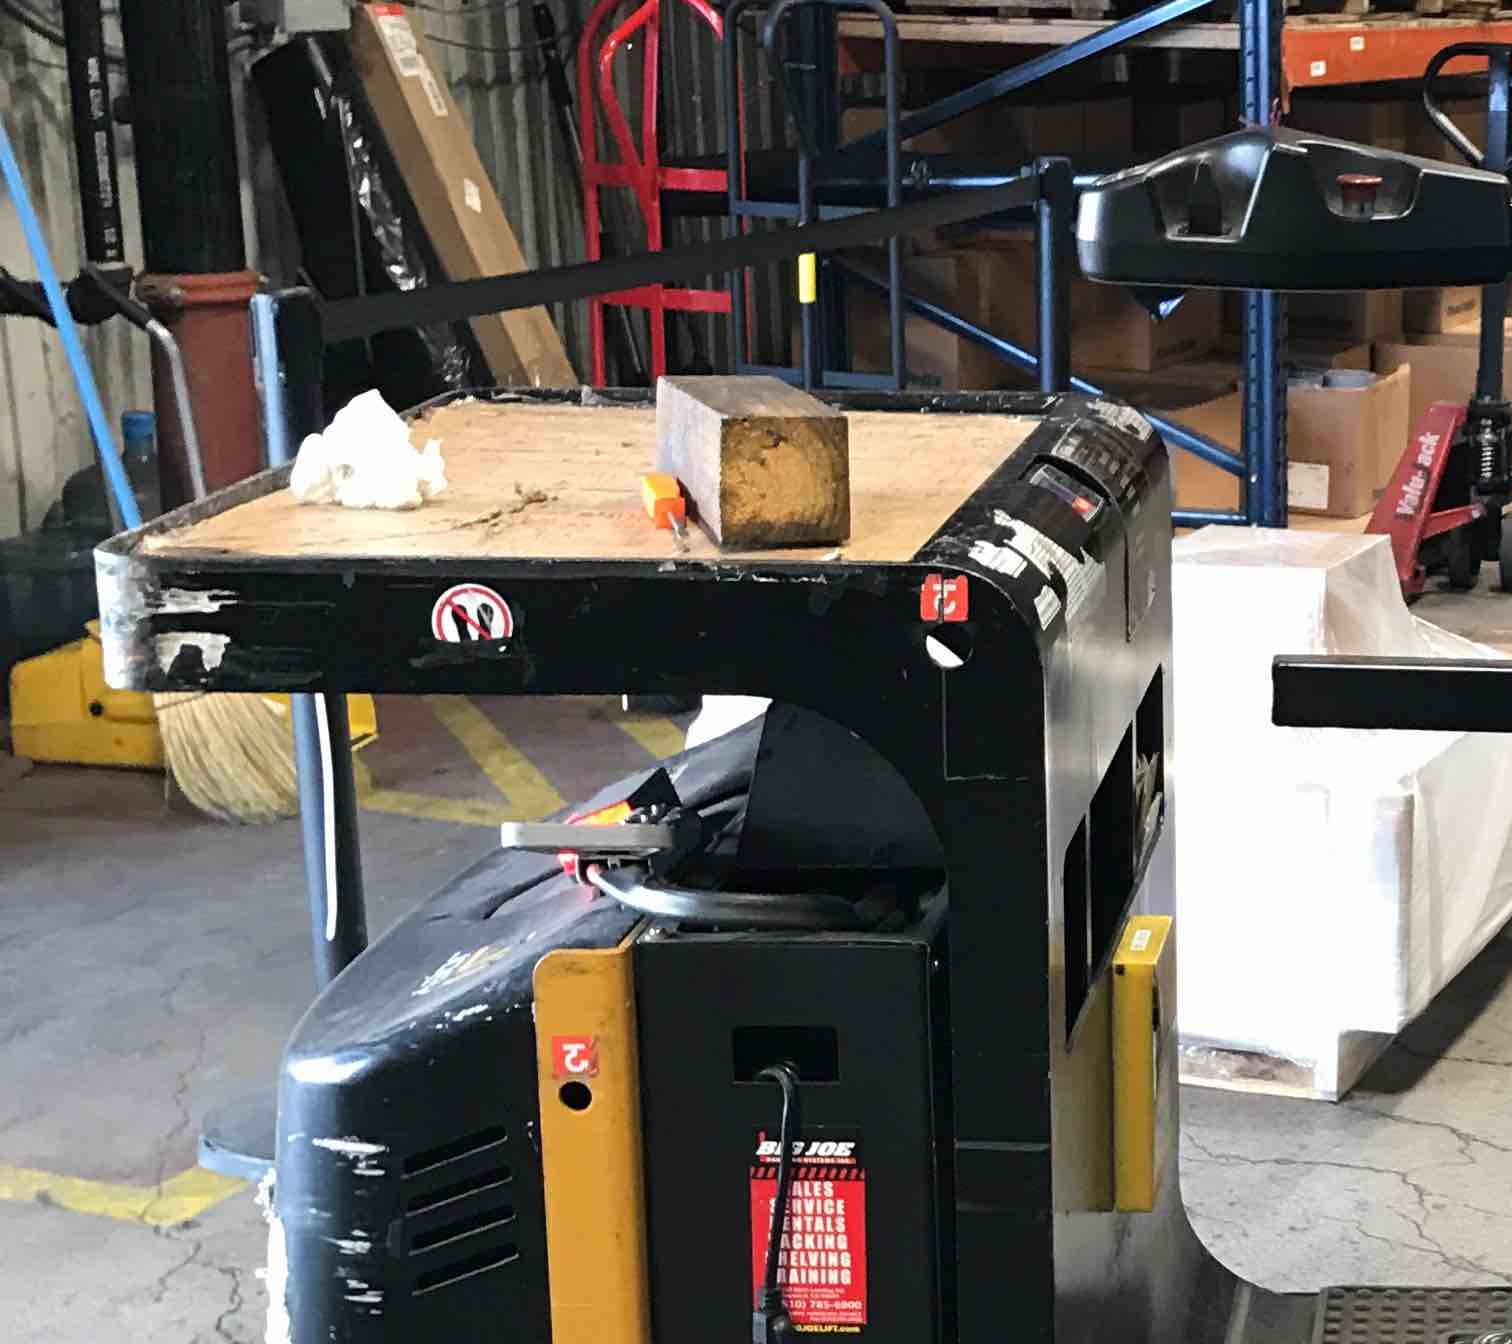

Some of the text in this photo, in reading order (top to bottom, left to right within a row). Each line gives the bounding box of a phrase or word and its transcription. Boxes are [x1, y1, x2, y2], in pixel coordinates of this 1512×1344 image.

[804, 1141, 856, 1157] JOE
[788, 1180, 834, 1198] ALES
[770, 1215, 847, 1233] ENTALS
[768, 1232, 849, 1250] ACKING
[765, 1250, 852, 1268] HELVING
[776, 1268, 852, 1284] RAINING
